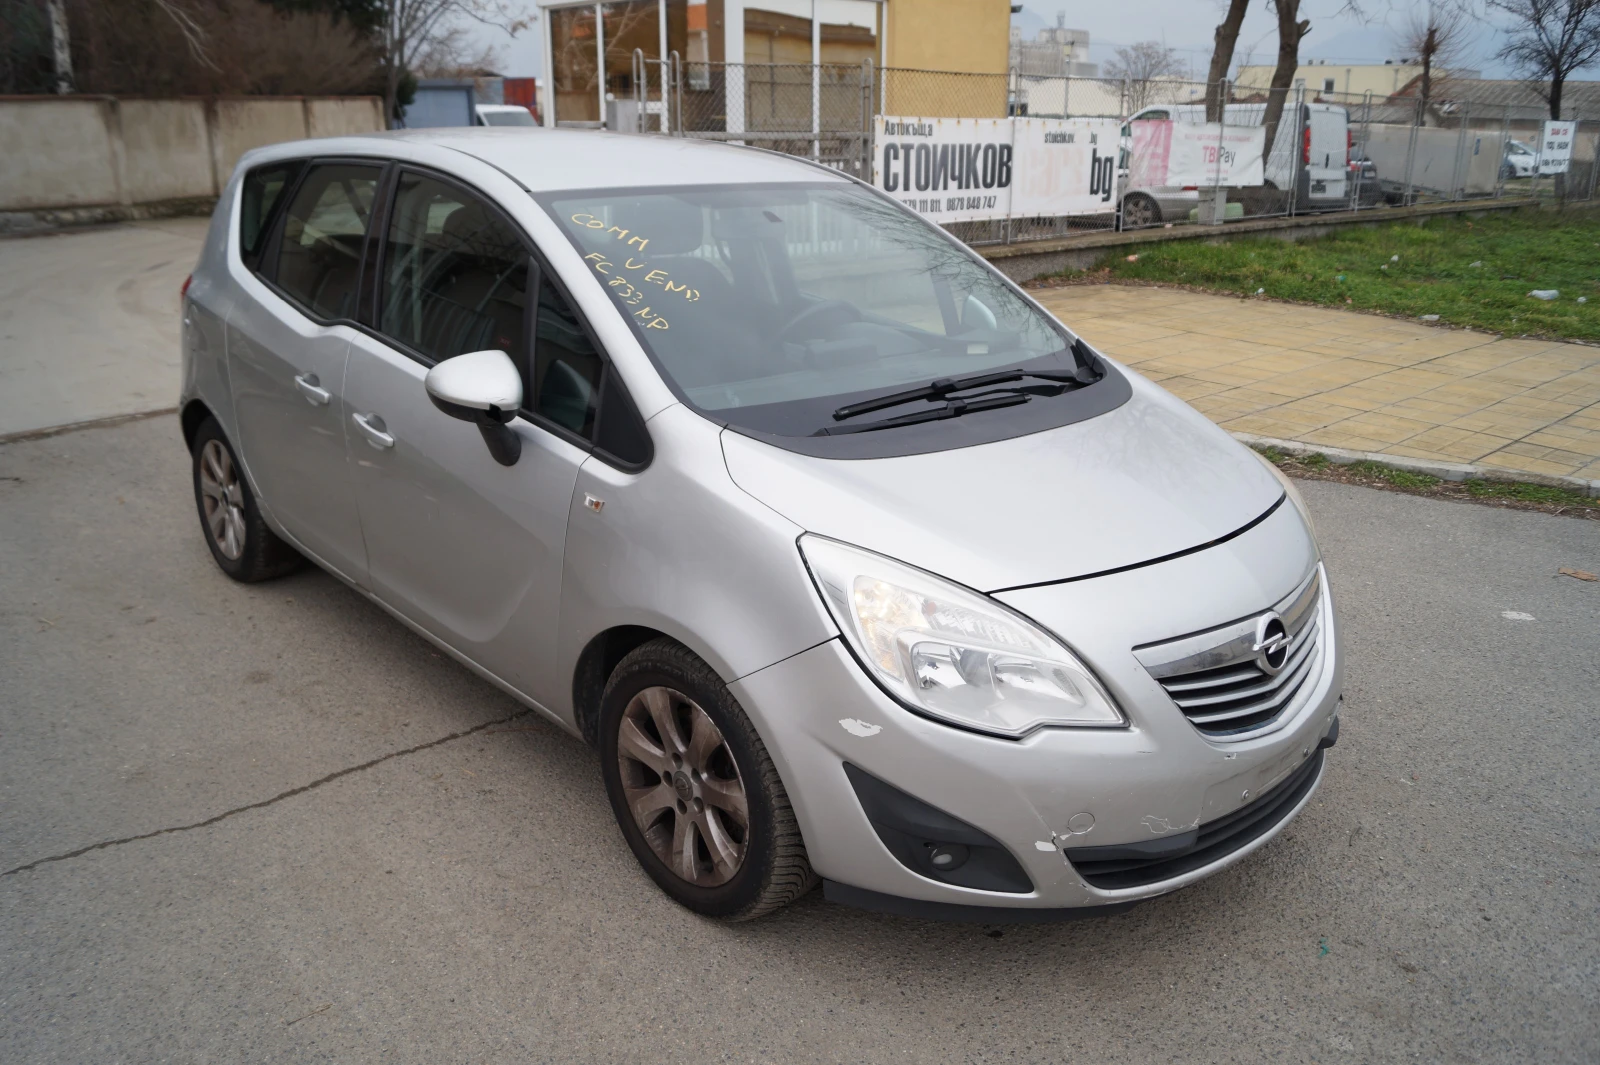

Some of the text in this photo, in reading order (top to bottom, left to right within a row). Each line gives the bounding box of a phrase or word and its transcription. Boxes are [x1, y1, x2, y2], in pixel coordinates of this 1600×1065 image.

[883, 142, 1013, 192] СТОИЧКОВ
[1089, 147, 1115, 202] bg
[946, 196, 965, 211] 0878
[966, 195, 981, 210] 848
[982, 195, 997, 209] 747
